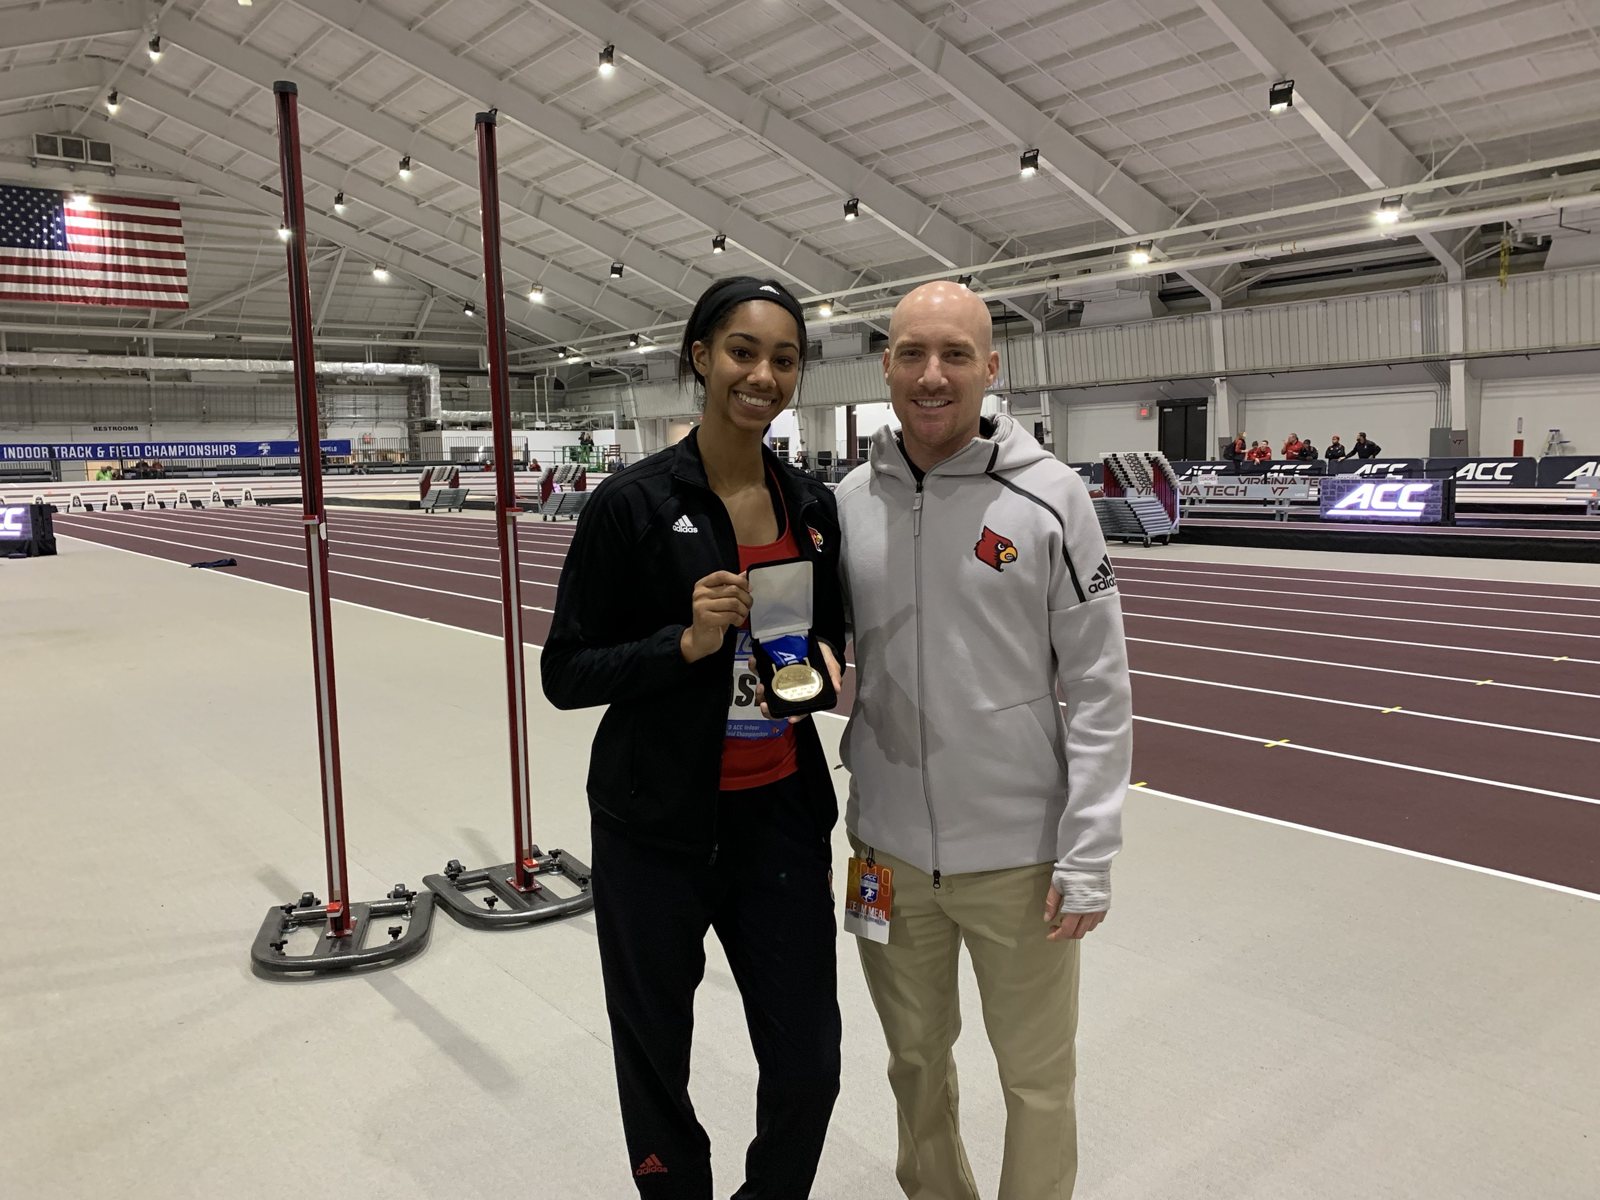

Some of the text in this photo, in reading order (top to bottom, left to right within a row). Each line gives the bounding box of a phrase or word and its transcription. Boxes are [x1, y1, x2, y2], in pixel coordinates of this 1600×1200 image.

[3, 444, 236, 459] INDOOR TRACK & FIELD CHAMPIONSHIPS
[1456, 462, 1519, 480] ACC
[1204, 485, 1248, 496] TECH
[1271, 487, 1289, 496] VT
[1334, 483, 1433, 509] ACC
[672, 525, 698, 533] adidas
[868, 906, 887, 921] MEAL
[636, 1165, 669, 1176] adidas
